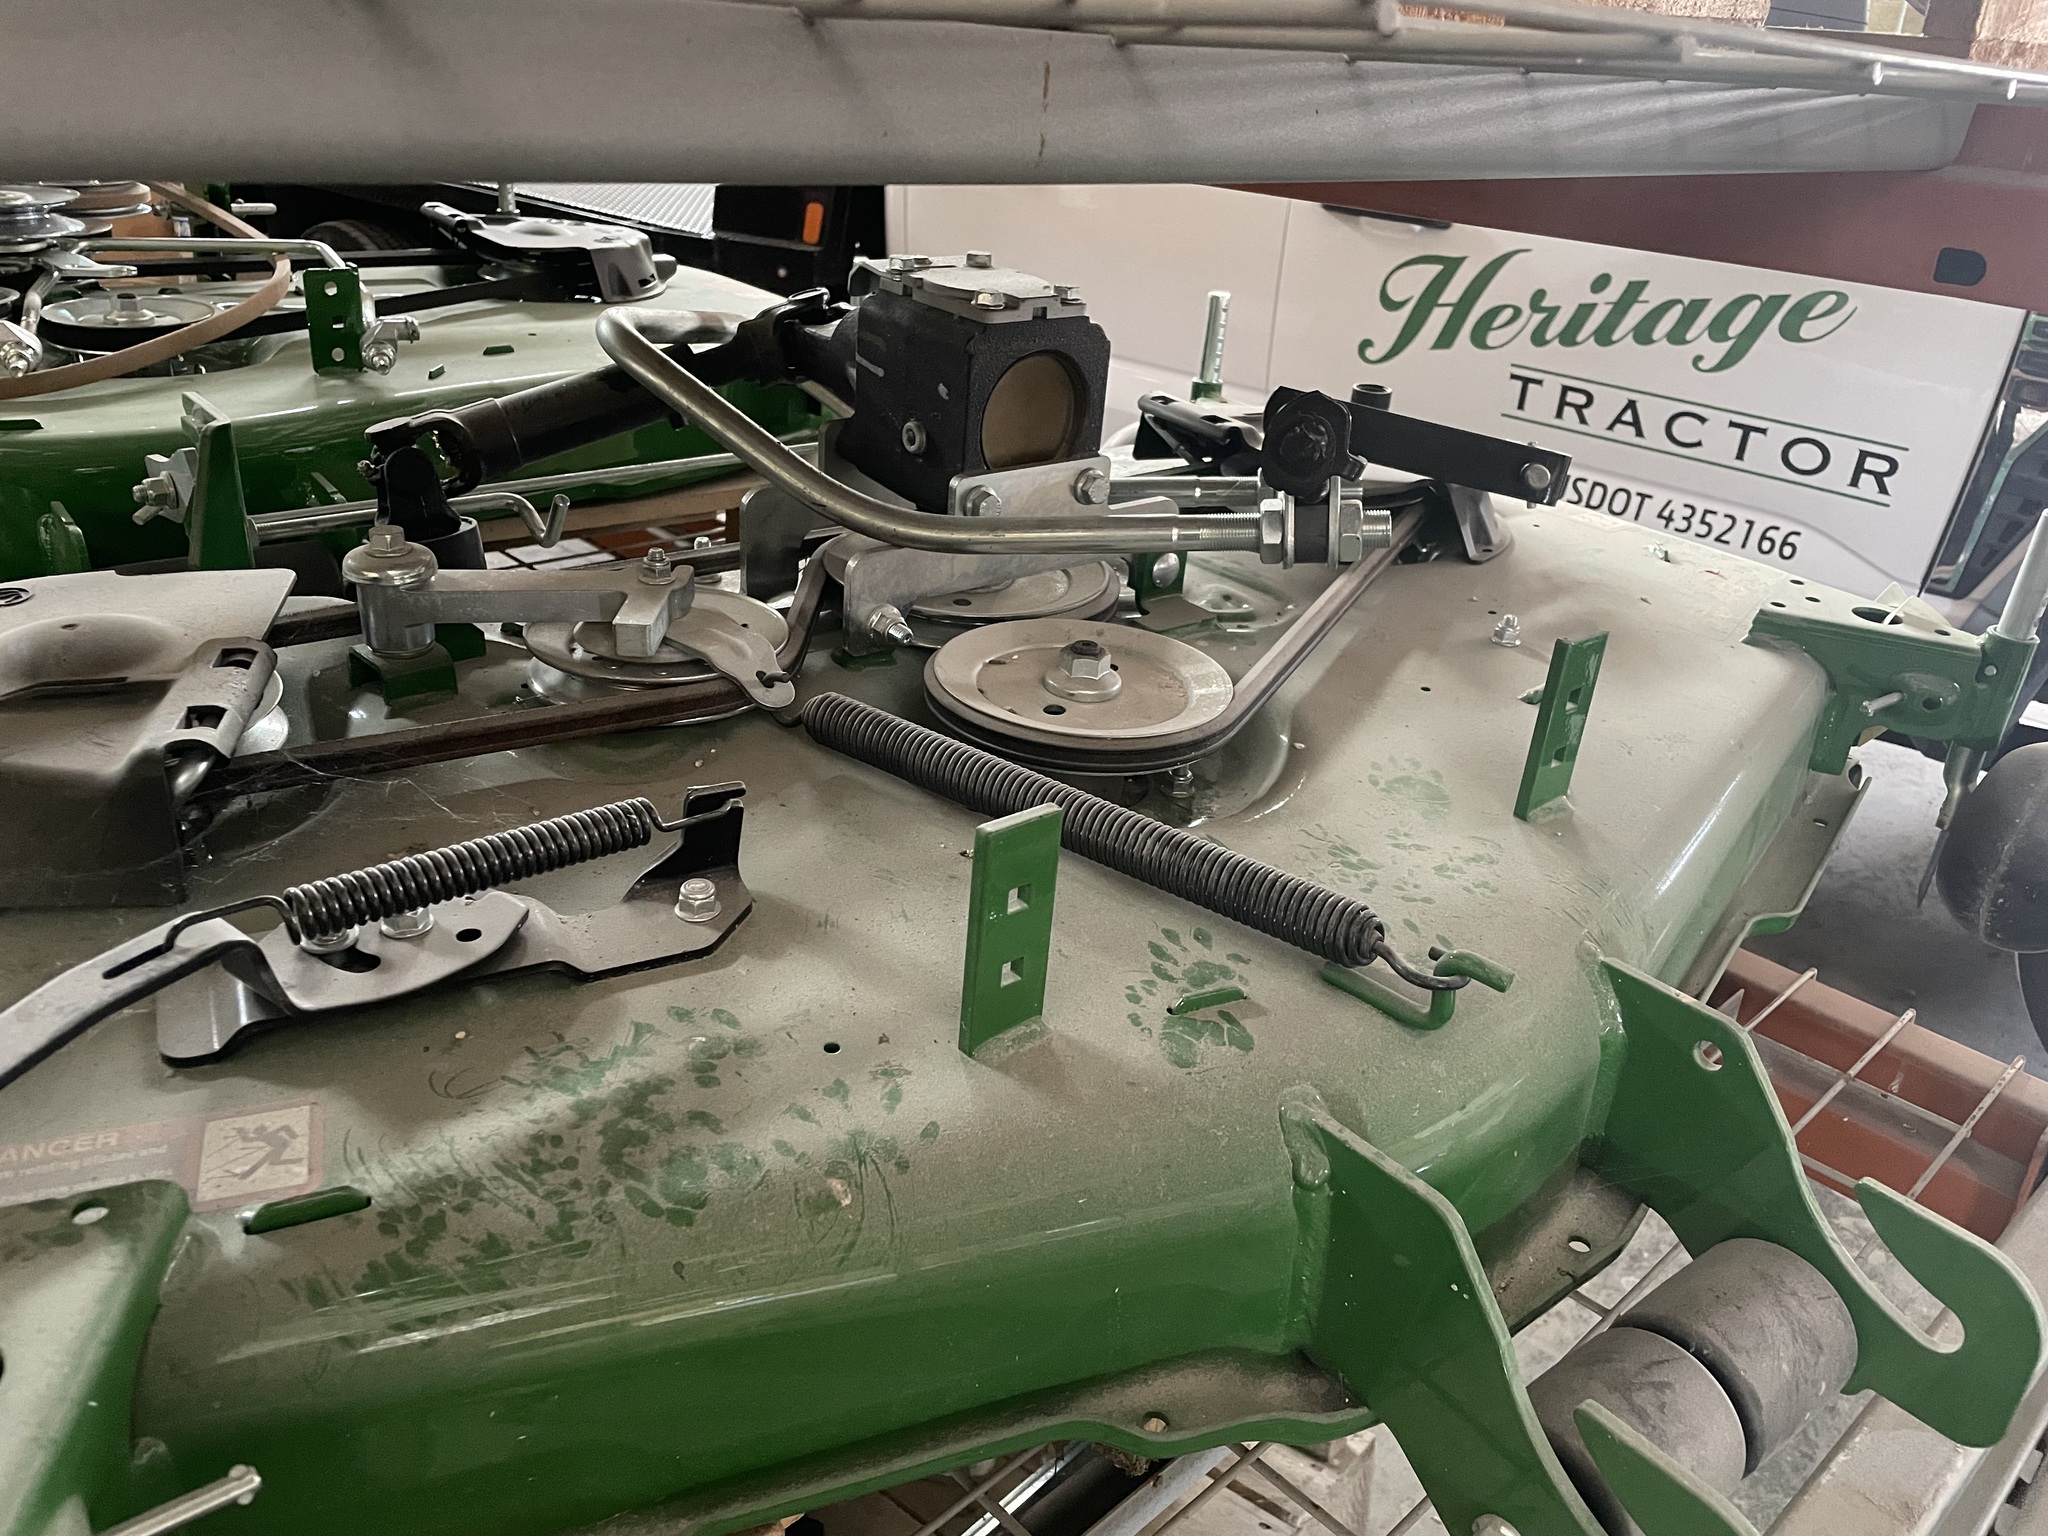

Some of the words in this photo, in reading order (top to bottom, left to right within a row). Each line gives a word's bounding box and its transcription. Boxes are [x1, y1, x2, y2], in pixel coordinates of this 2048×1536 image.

[1358, 248, 1858, 372] Heritage
[1509, 374, 1899, 496] TRACTOR
[1656, 499, 1802, 561] 4352166
